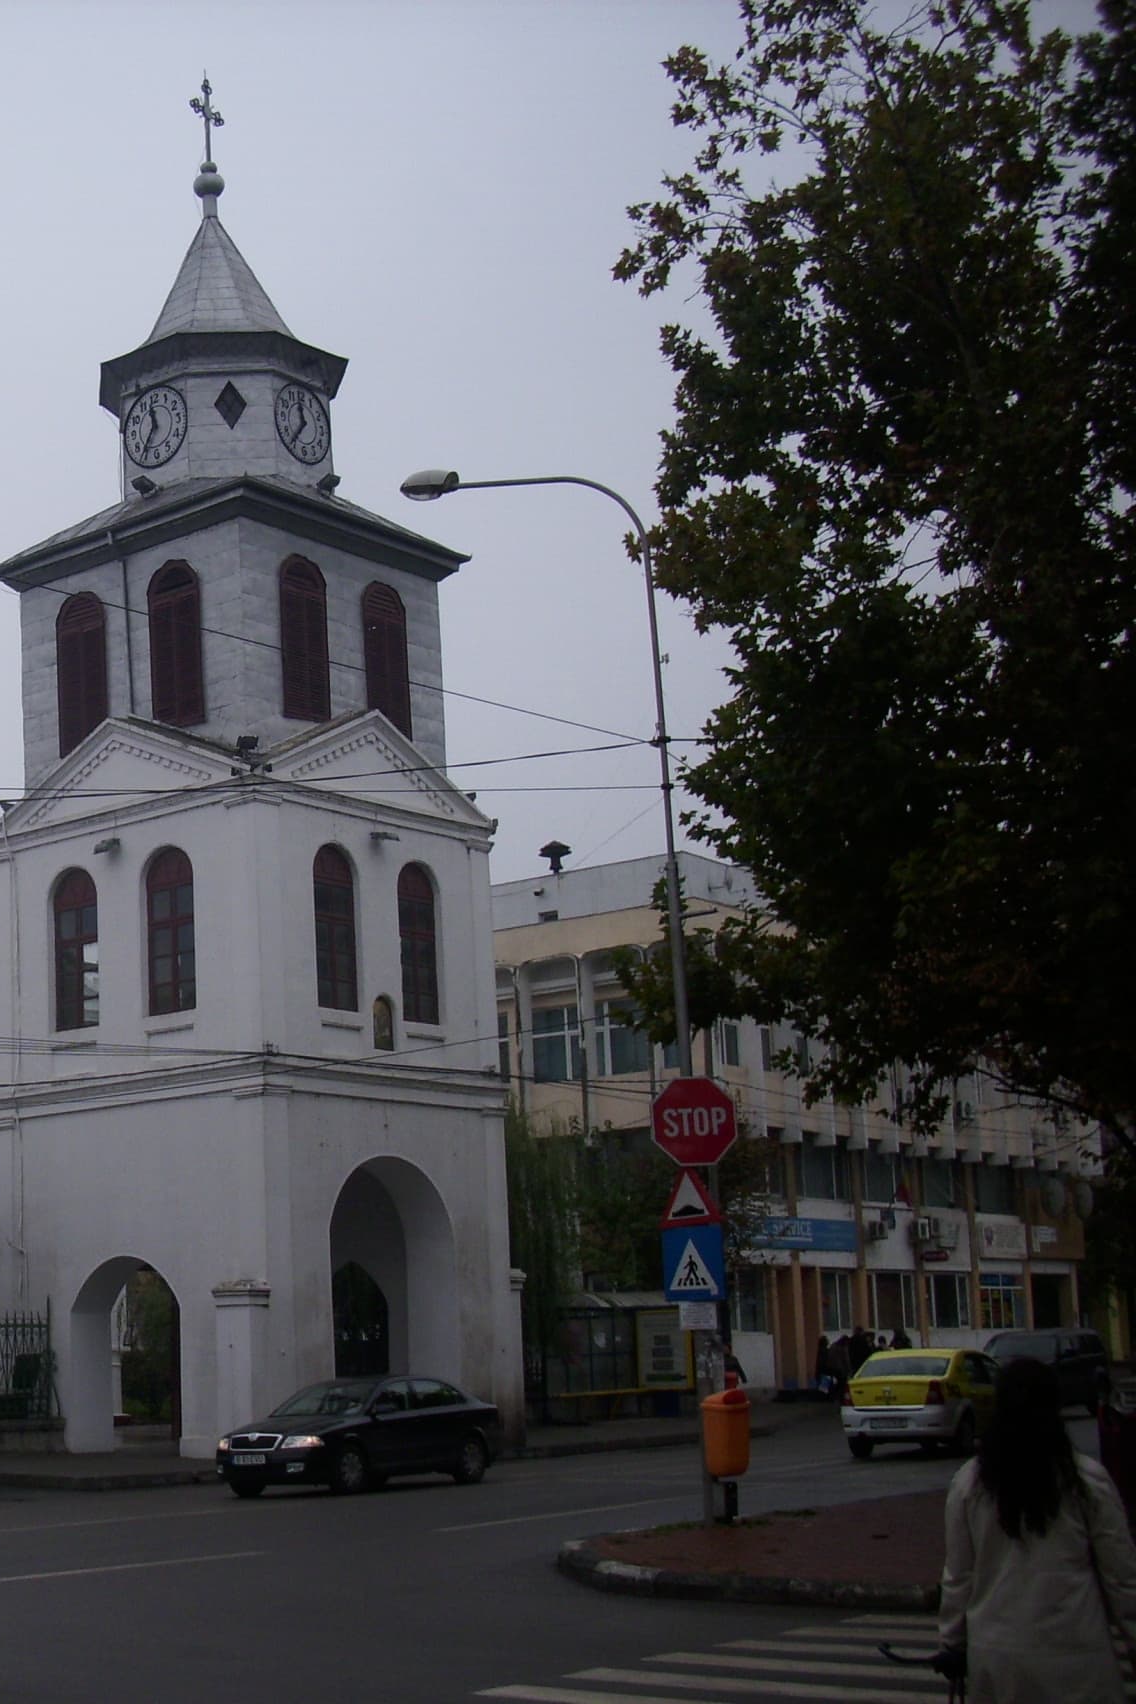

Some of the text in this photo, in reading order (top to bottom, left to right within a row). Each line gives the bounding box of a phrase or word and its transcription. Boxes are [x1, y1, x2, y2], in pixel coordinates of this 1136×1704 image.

[150, 393, 159, 404] 12
[140, 401, 147, 413] 11
[171, 400, 178, 411] 2
[132, 415, 140, 426] 10
[175, 412, 181, 424] 3
[131, 430, 137, 440] 9
[173, 427, 180, 438] 4
[134, 441, 141, 453] 8
[165, 440, 171, 453] 5
[153, 448, 160, 460] 6
[663, 1106, 727, 1137] STOP
